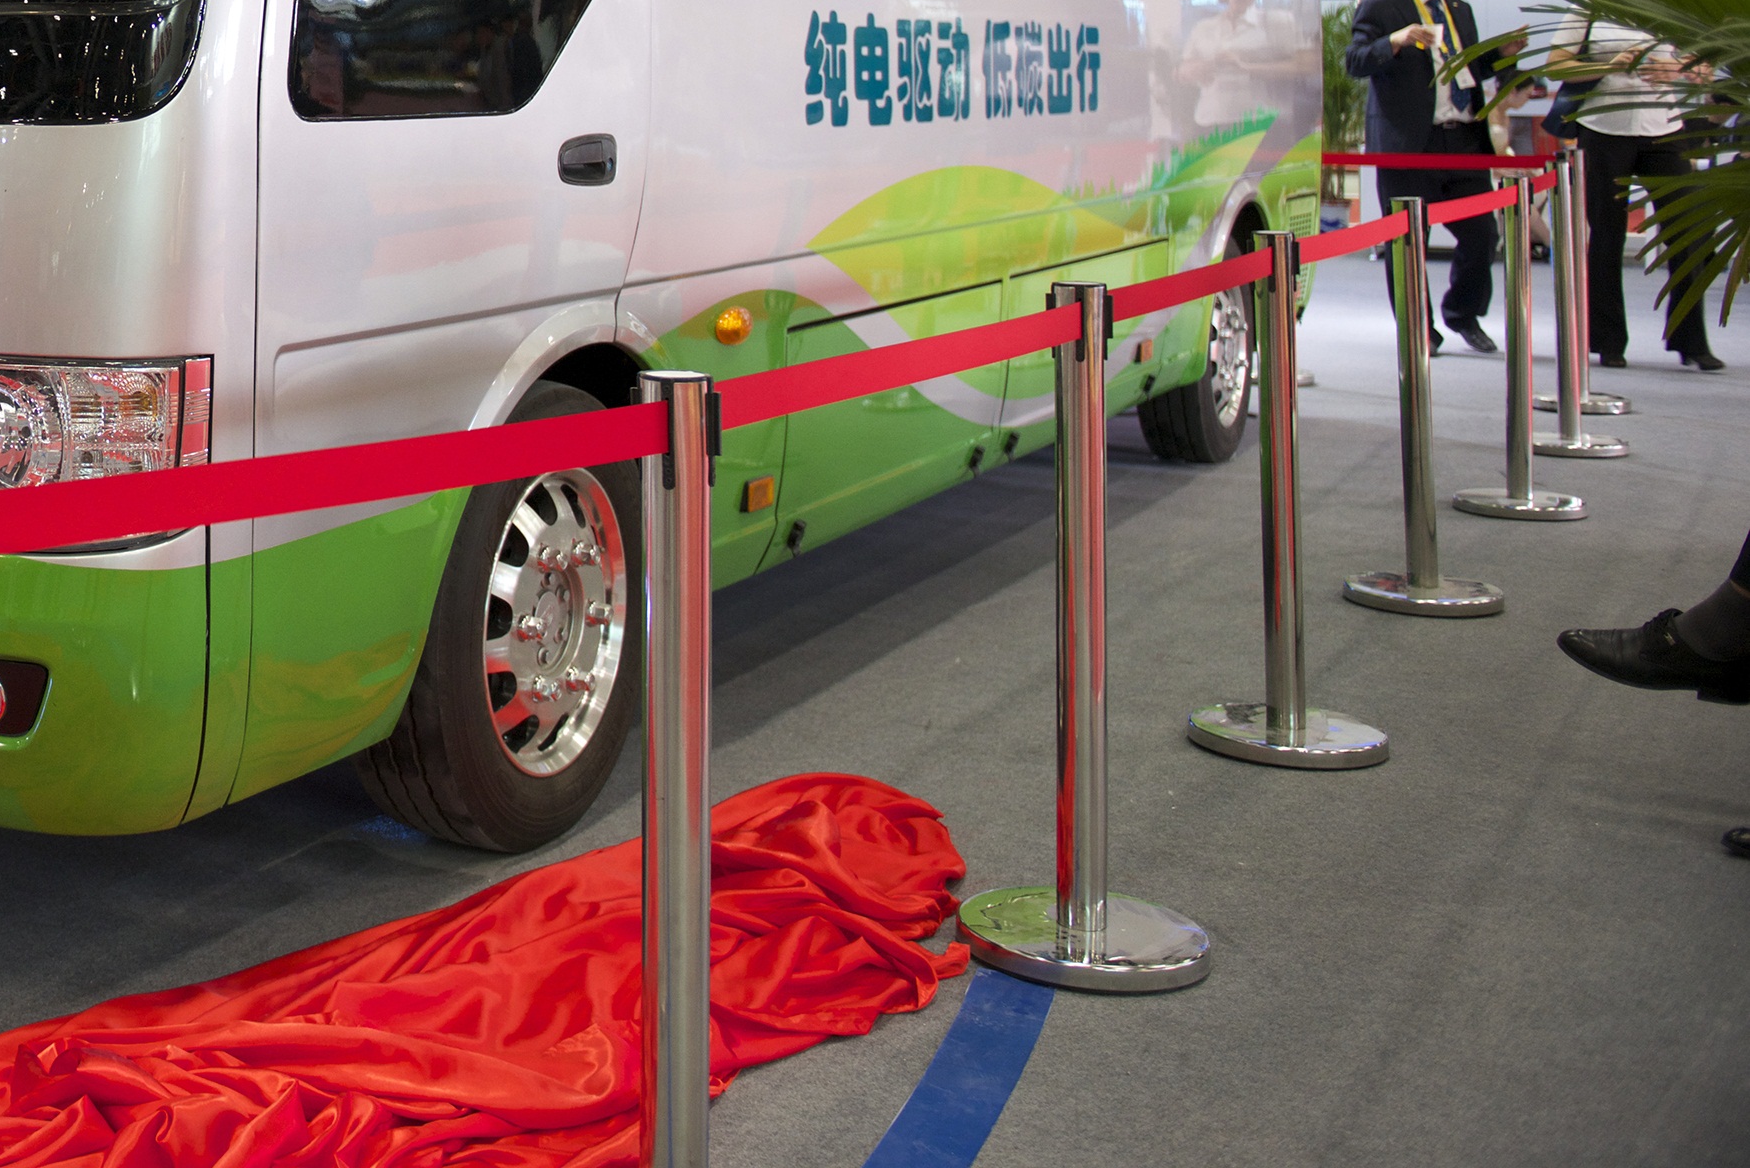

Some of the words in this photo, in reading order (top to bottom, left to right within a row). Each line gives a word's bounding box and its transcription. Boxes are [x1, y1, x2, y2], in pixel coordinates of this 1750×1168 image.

[804, 10, 971, 127] 纯电驱动
[982, 18, 1101, 120] 低碳出行
